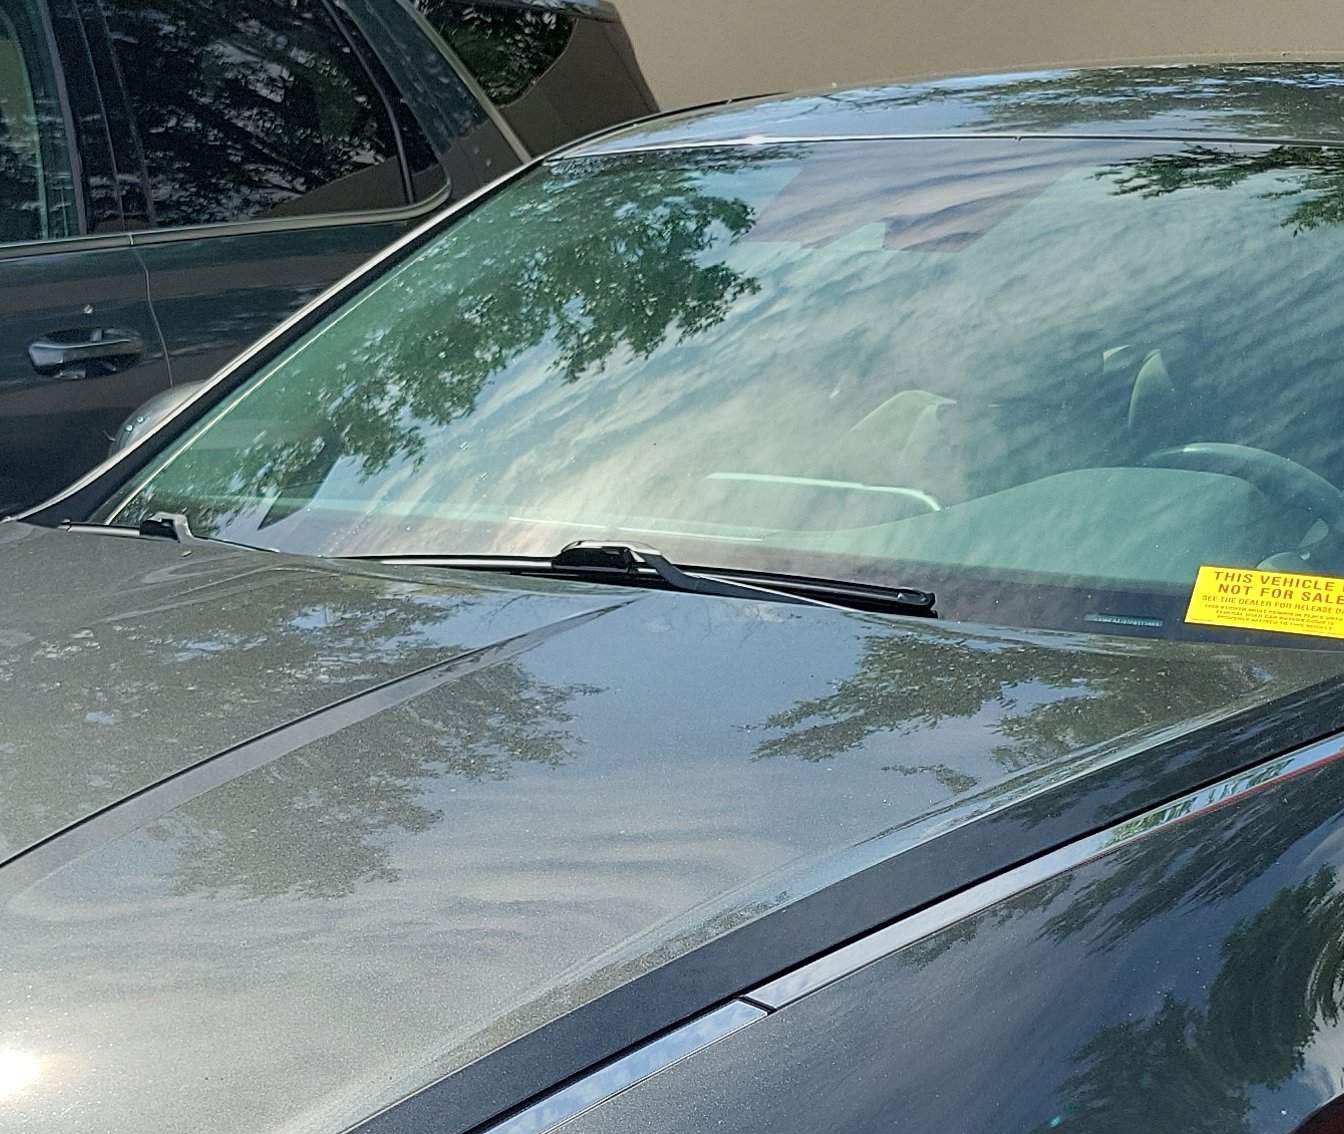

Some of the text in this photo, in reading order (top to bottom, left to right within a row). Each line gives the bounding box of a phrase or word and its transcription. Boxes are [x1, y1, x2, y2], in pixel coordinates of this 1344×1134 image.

[1214, 571, 1253, 583] THIS
[1260, 575, 1335, 591] VEHICLE
[1218, 583, 1253, 595] NOT
[1260, 587, 1293, 599] FOR
[1220, 596, 1236, 604] THE
[1239, 598, 1272, 608] DEALER
[1274, 601, 1291, 609] FOR
[1294, 603, 1333, 614] RELEASE
